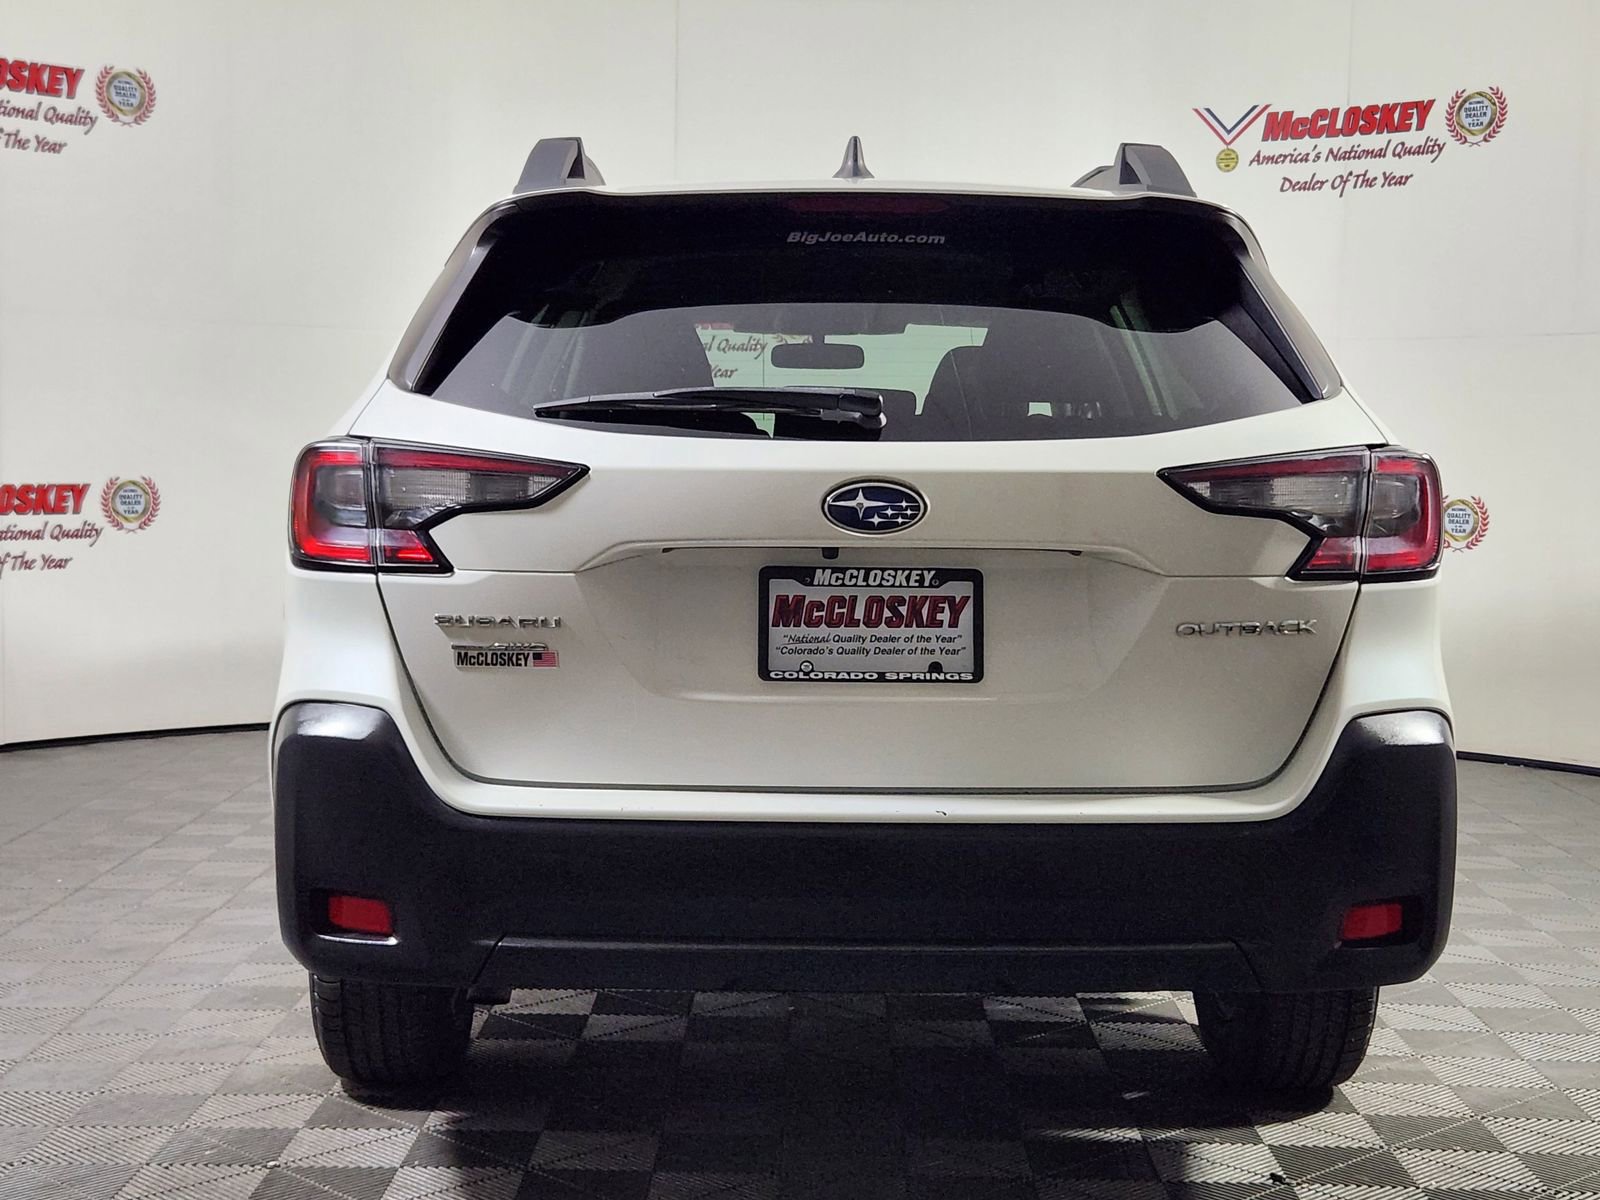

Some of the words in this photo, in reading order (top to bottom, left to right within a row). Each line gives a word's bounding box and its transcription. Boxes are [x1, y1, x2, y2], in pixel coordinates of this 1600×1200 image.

[1464, 105, 1489, 113] QUALITY
[43, 106, 98, 135] Quality
[1262, 99, 1436, 142] McCLOSKEY
[4, 129, 31, 151] The
[34, 135, 68, 154] Year
[1249, 144, 1321, 166] America's
[1325, 139, 1391, 163] National
[1392, 136, 1446, 163] Quality
[1279, 173, 1329, 193] Dealer
[1331, 170, 1353, 198] Of
[1353, 169, 1377, 189] The
[1381, 171, 1413, 189] Year
[787, 231, 945, 245] BigJoeAuto.com
[717, 335, 768, 360] Quality
[50, 520, 104, 547] Quality
[11, 551, 37, 571] The
[40, 554, 73, 571] Year
[813, 569, 936, 587] McCLOSKEY
[771, 595, 971, 628] McCLOSKEY
[434, 614, 561, 629] SUBARU
[1176, 619, 1317, 637] OUTBACK
[832, 634, 867, 645] Quality
[869, 634, 901, 643] Dealer
[903, 634, 915, 643] of
[916, 634, 932, 643] the
[456, 651, 530, 667] McCLOSKEY
[836, 646, 871, 657] Quality
[873, 646, 906, 655] Dealer
[907, 646, 919, 655] of
[920, 646, 936, 655] the
[770, 671, 878, 680] COLORADO
[885, 672, 973, 680] SPRINGS
